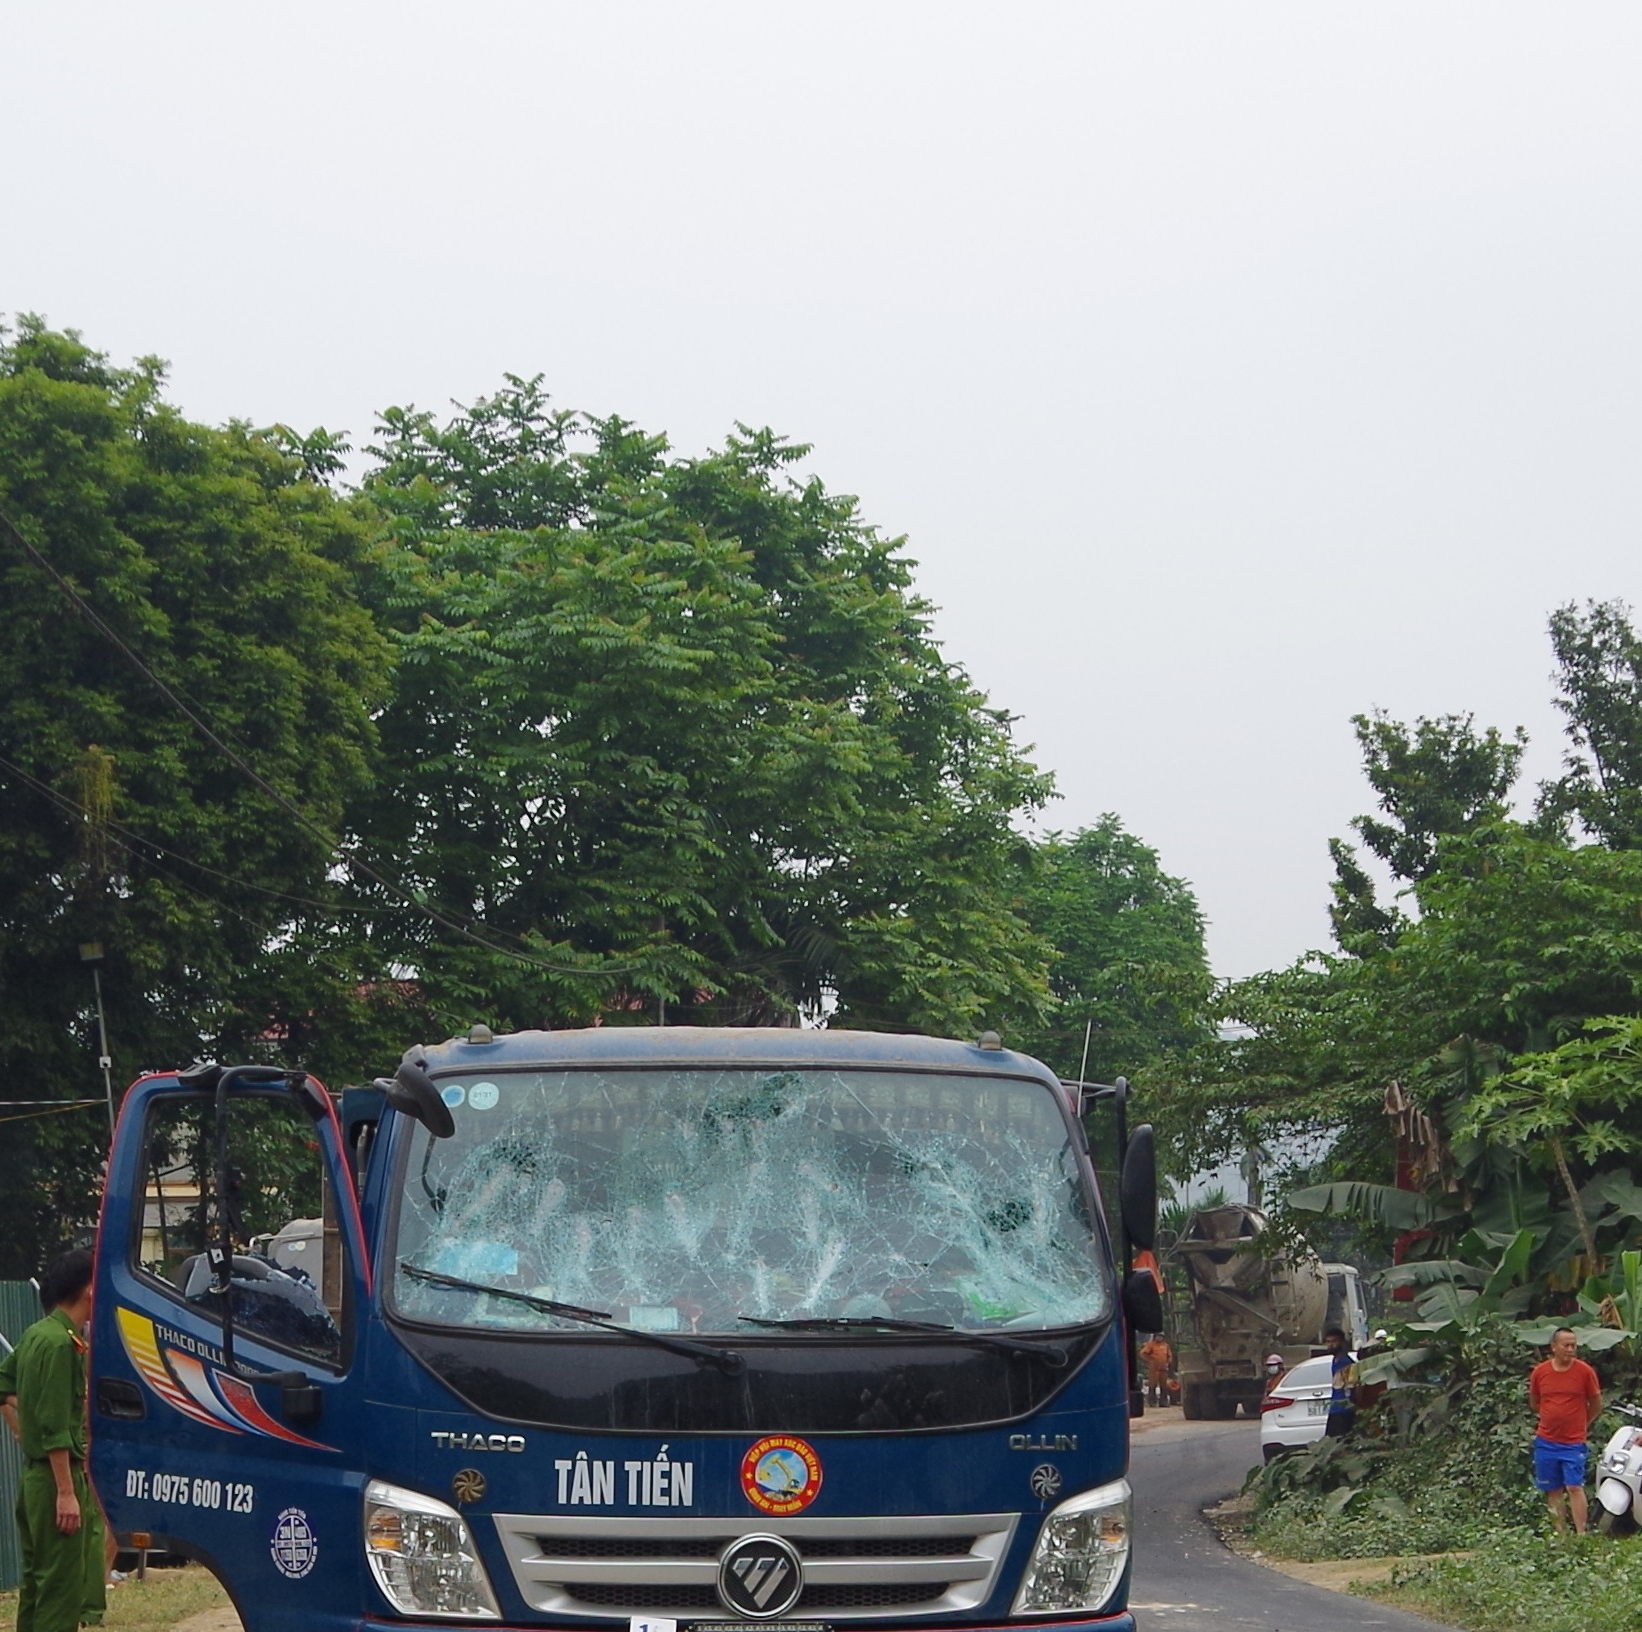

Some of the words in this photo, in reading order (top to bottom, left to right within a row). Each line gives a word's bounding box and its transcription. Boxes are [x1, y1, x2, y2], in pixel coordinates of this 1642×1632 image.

[155, 1324, 195, 1353] THACO
[431, 1431, 526, 1453] THACO
[1009, 1434, 1078, 1451] OLLIN
[554, 1450, 615, 1505] TÂN
[624, 1444, 694, 1507] TIẾN
[126, 1469, 149, 1499] ĐT:
[152, 1473, 189, 1505] 0975
[192, 1478, 221, 1509] 600
[225, 1482, 254, 1514] 123
